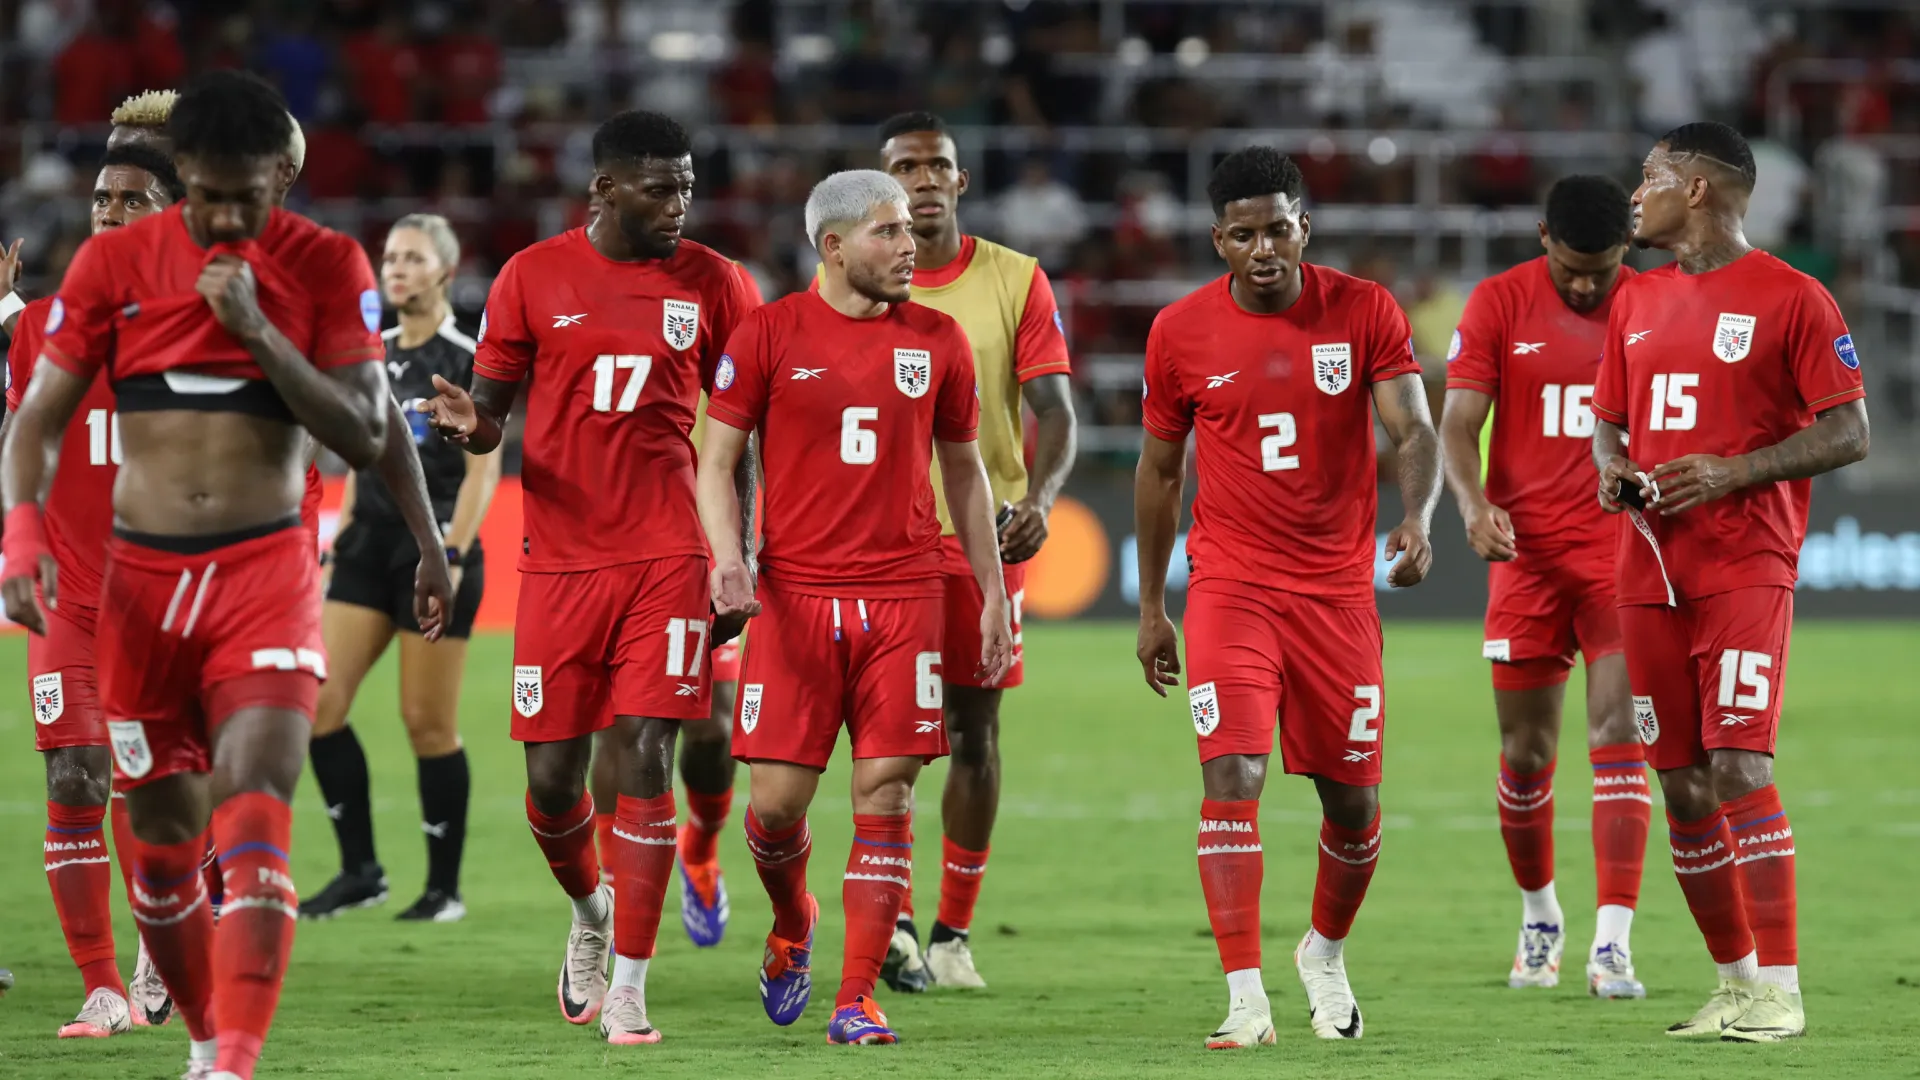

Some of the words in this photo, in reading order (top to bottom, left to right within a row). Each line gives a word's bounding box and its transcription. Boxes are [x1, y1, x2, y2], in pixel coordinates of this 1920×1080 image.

[667, 302, 696, 312] PANAMA
[1721, 316, 1752, 325] PANAMA
[592, 355, 653, 413] 17
[897, 351, 927, 359] PANAMA
[1540, 383, 1597, 438] 16
[1649, 373, 1700, 431] 15
[840, 406, 880, 465] 6
[1258, 411, 1301, 472] 2
[665, 617, 709, 677] 17
[915, 651, 943, 709] 6
[1717, 648, 1772, 711] 15
[1347, 684, 1380, 742] 2
[1199, 820, 1253, 833] PANAMA
